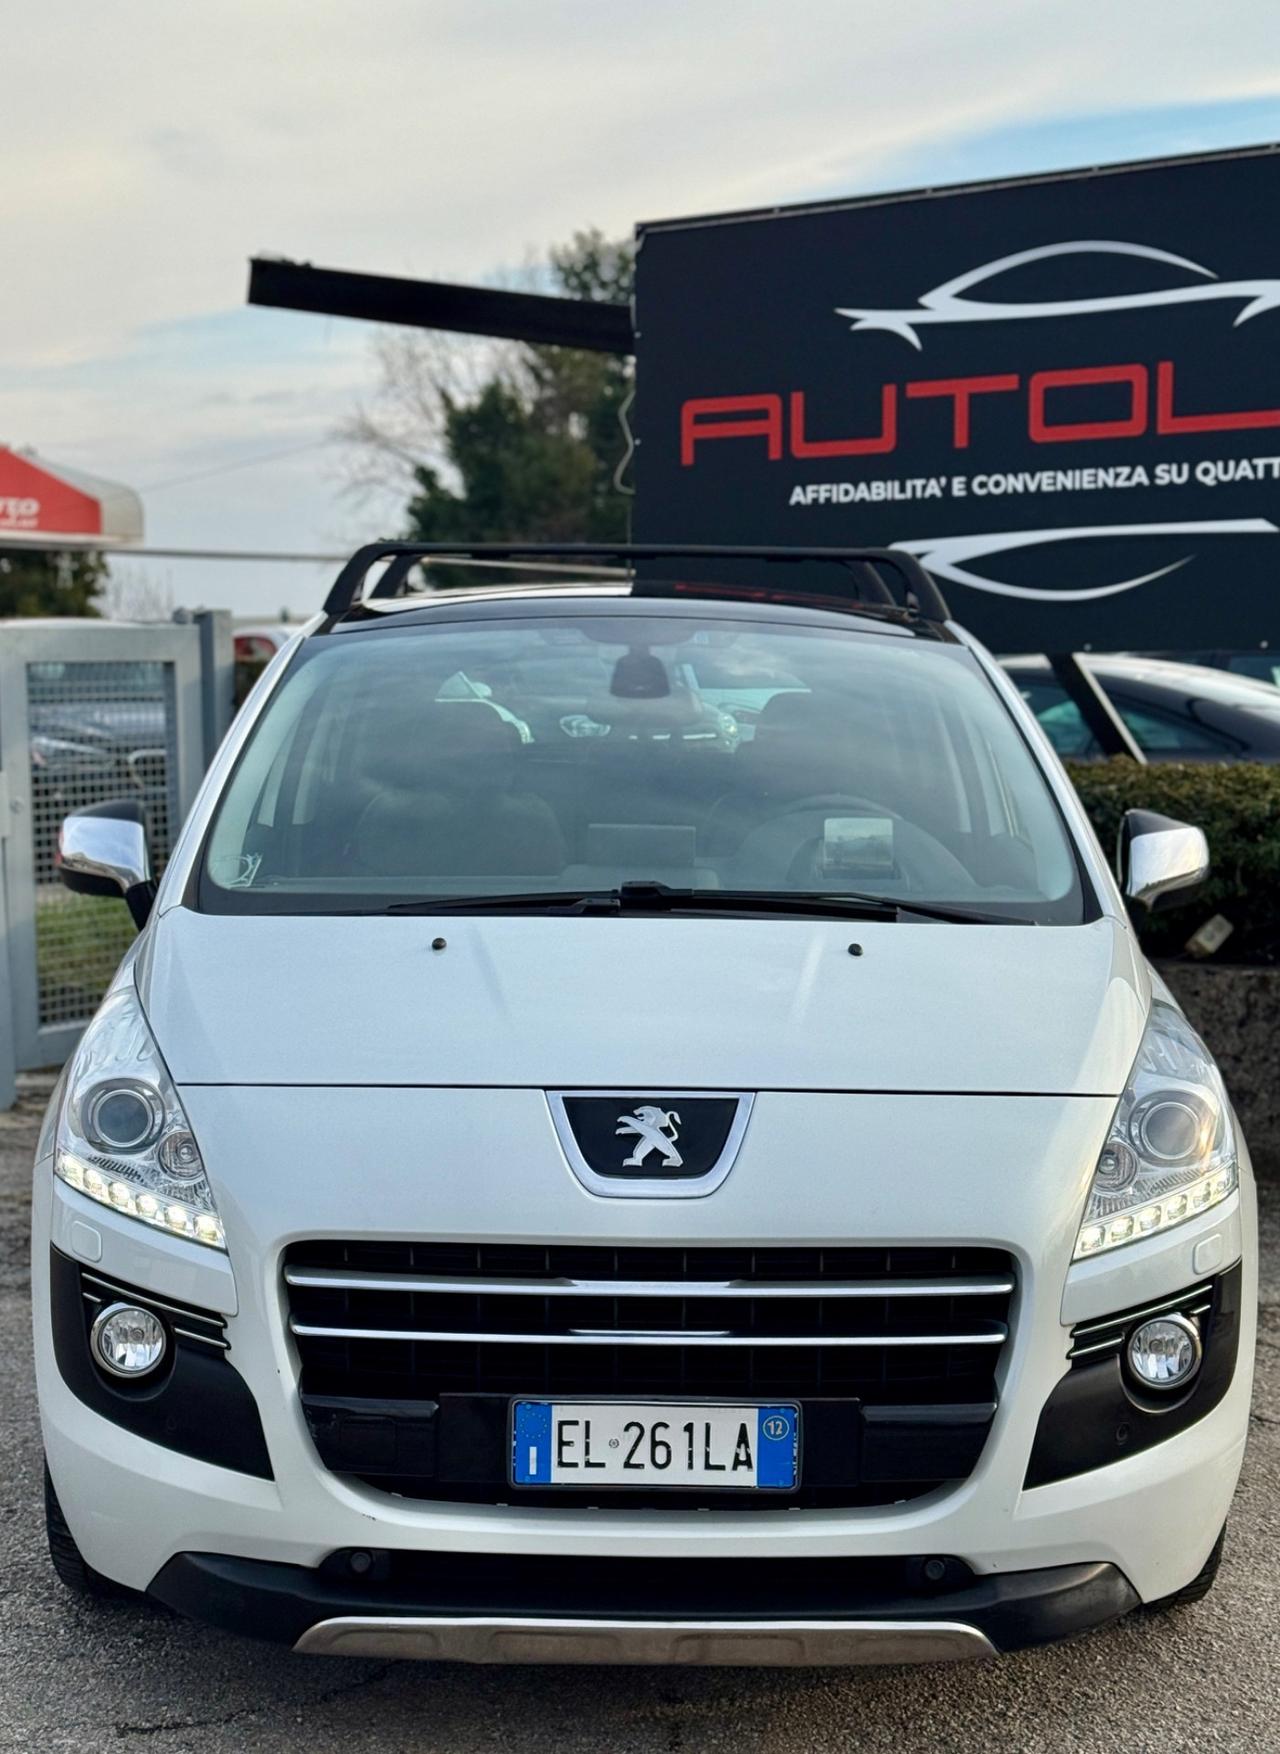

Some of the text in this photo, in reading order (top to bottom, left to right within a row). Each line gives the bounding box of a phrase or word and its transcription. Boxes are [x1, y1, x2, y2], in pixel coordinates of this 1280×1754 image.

[789, 476, 947, 505] AFFIDABILITA'
[952, 476, 967, 496] E
[972, 465, 1149, 495] CONVENIENZA
[1154, 462, 1189, 485] SU
[767, 1420, 783, 1435] 12
